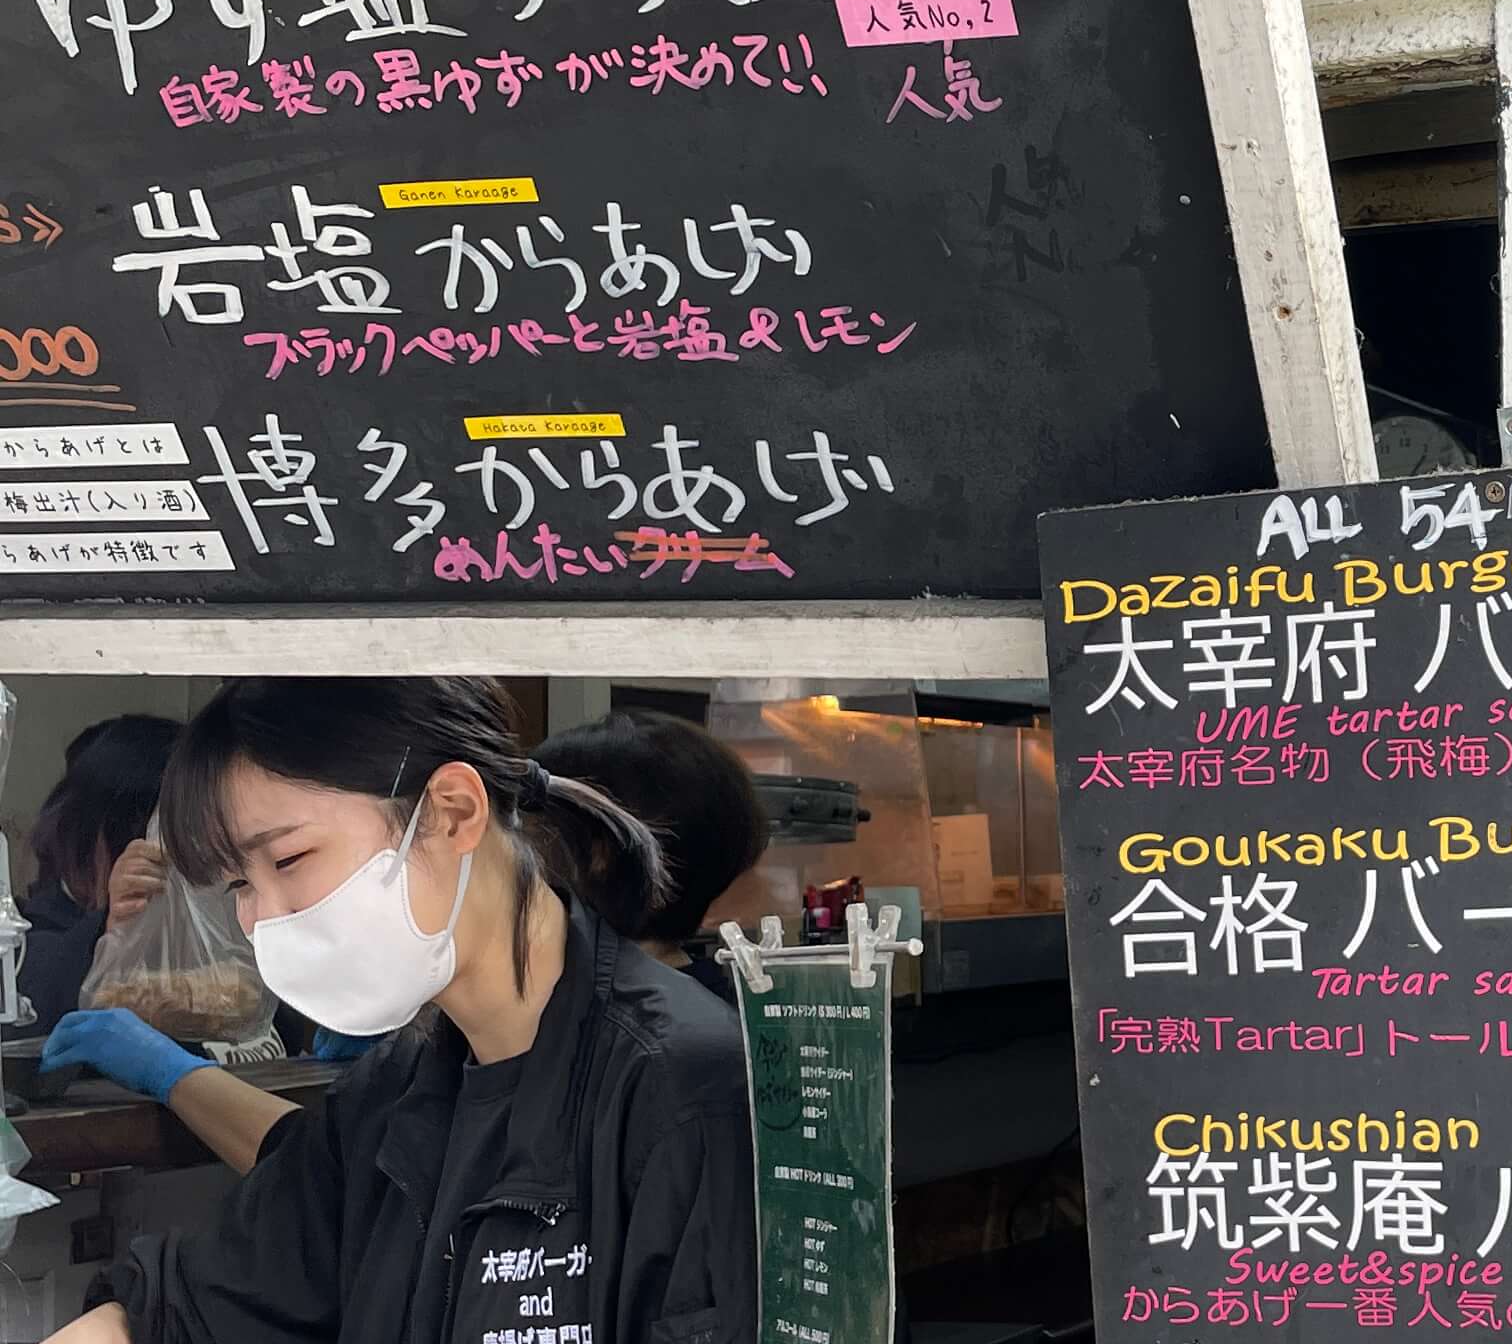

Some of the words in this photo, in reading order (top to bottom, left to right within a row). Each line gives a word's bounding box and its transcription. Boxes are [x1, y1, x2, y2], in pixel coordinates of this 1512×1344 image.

[886, 41, 1003, 124] 人気
[399, 187, 448, 202] Ganen
[455, 183, 519, 199] Karaage
[4, 436, 164, 458] からあげとは
[482, 421, 538, 435] Hakata
[545, 417, 607, 434] Karaage
[1257, 494, 1363, 560] ALL
[1060, 565, 1315, 624] Dazaifu
[1196, 704, 1303, 742] UME
[1327, 701, 1464, 737] tartar
[1119, 827, 1410, 874] Goukaku
[1311, 965, 1450, 1000] Tartar
[1154, 1111, 1480, 1156] Chikushian
[1224, 1247, 1504, 1295] Sweet&spice
[519, 1286, 554, 1317] and
